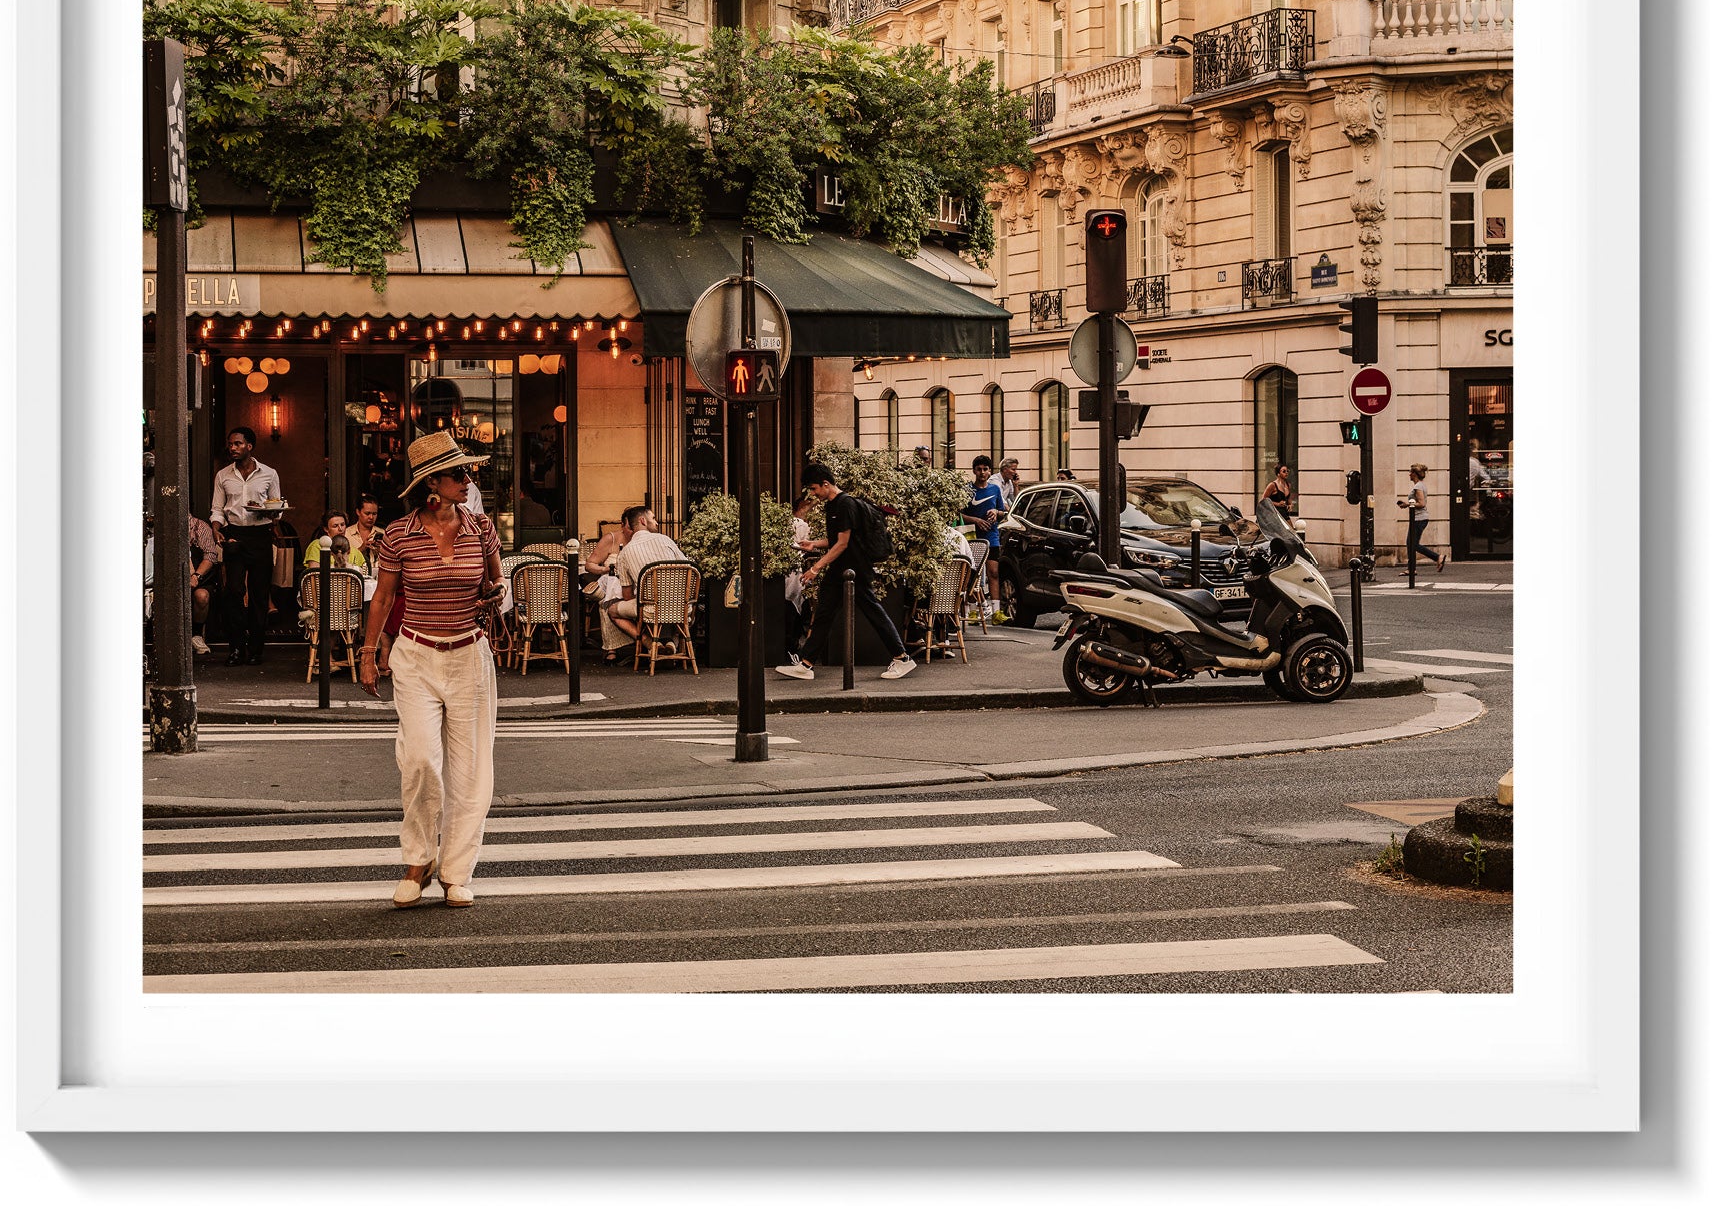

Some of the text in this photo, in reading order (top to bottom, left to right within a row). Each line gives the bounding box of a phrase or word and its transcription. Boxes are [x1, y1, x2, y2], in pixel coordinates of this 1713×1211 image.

[1484, 329, 1513, 347] SG
[685, 397, 697, 405] RINK
[703, 397, 719, 405] BREAK
[705, 407, 717, 416] FAST
[693, 418, 710, 427] LUNCH
[693, 428, 708, 436] WELL
